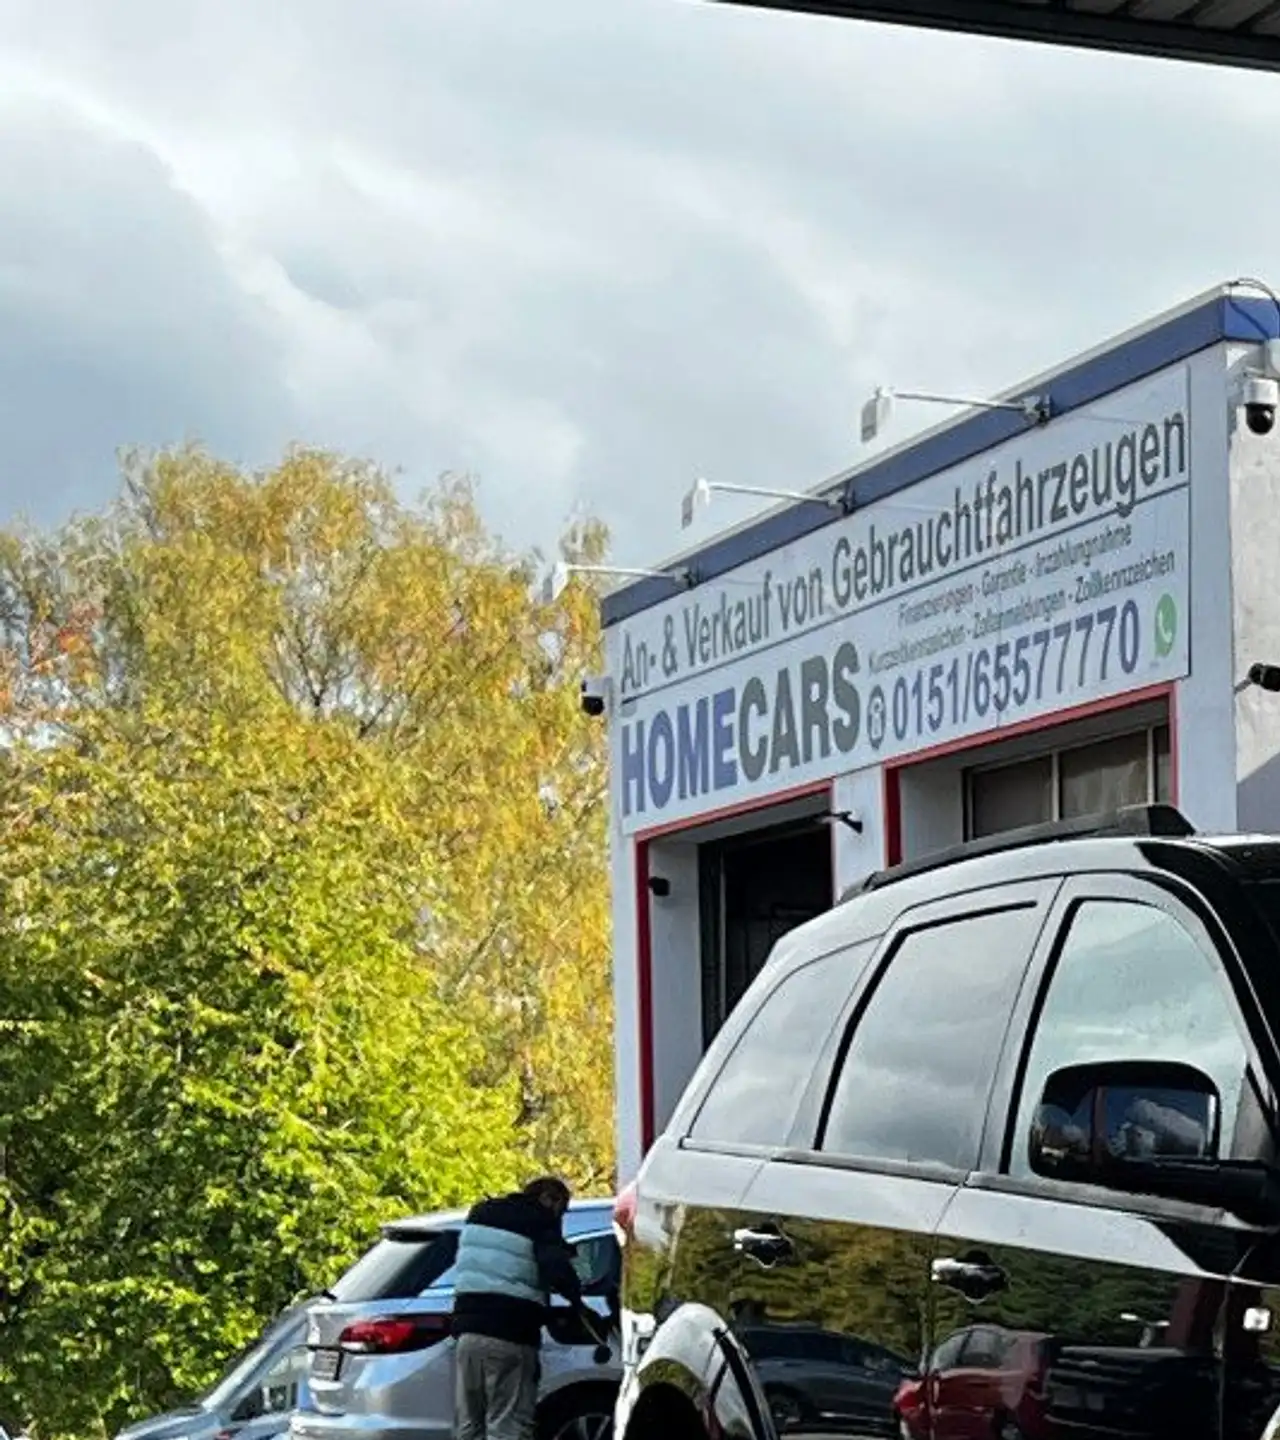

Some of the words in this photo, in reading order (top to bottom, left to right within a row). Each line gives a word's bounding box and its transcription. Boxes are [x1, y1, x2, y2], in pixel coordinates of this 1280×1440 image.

[621, 630, 656, 694] An-
[661, 614, 678, 678] &
[683, 569, 773, 668] Verkauf
[778, 566, 823, 631] von
[832, 411, 1186, 608] Gebrauchtfahrzeugen
[621, 641, 860, 817] HOMECARS
[892, 599, 1140, 741] 0151/65577770
